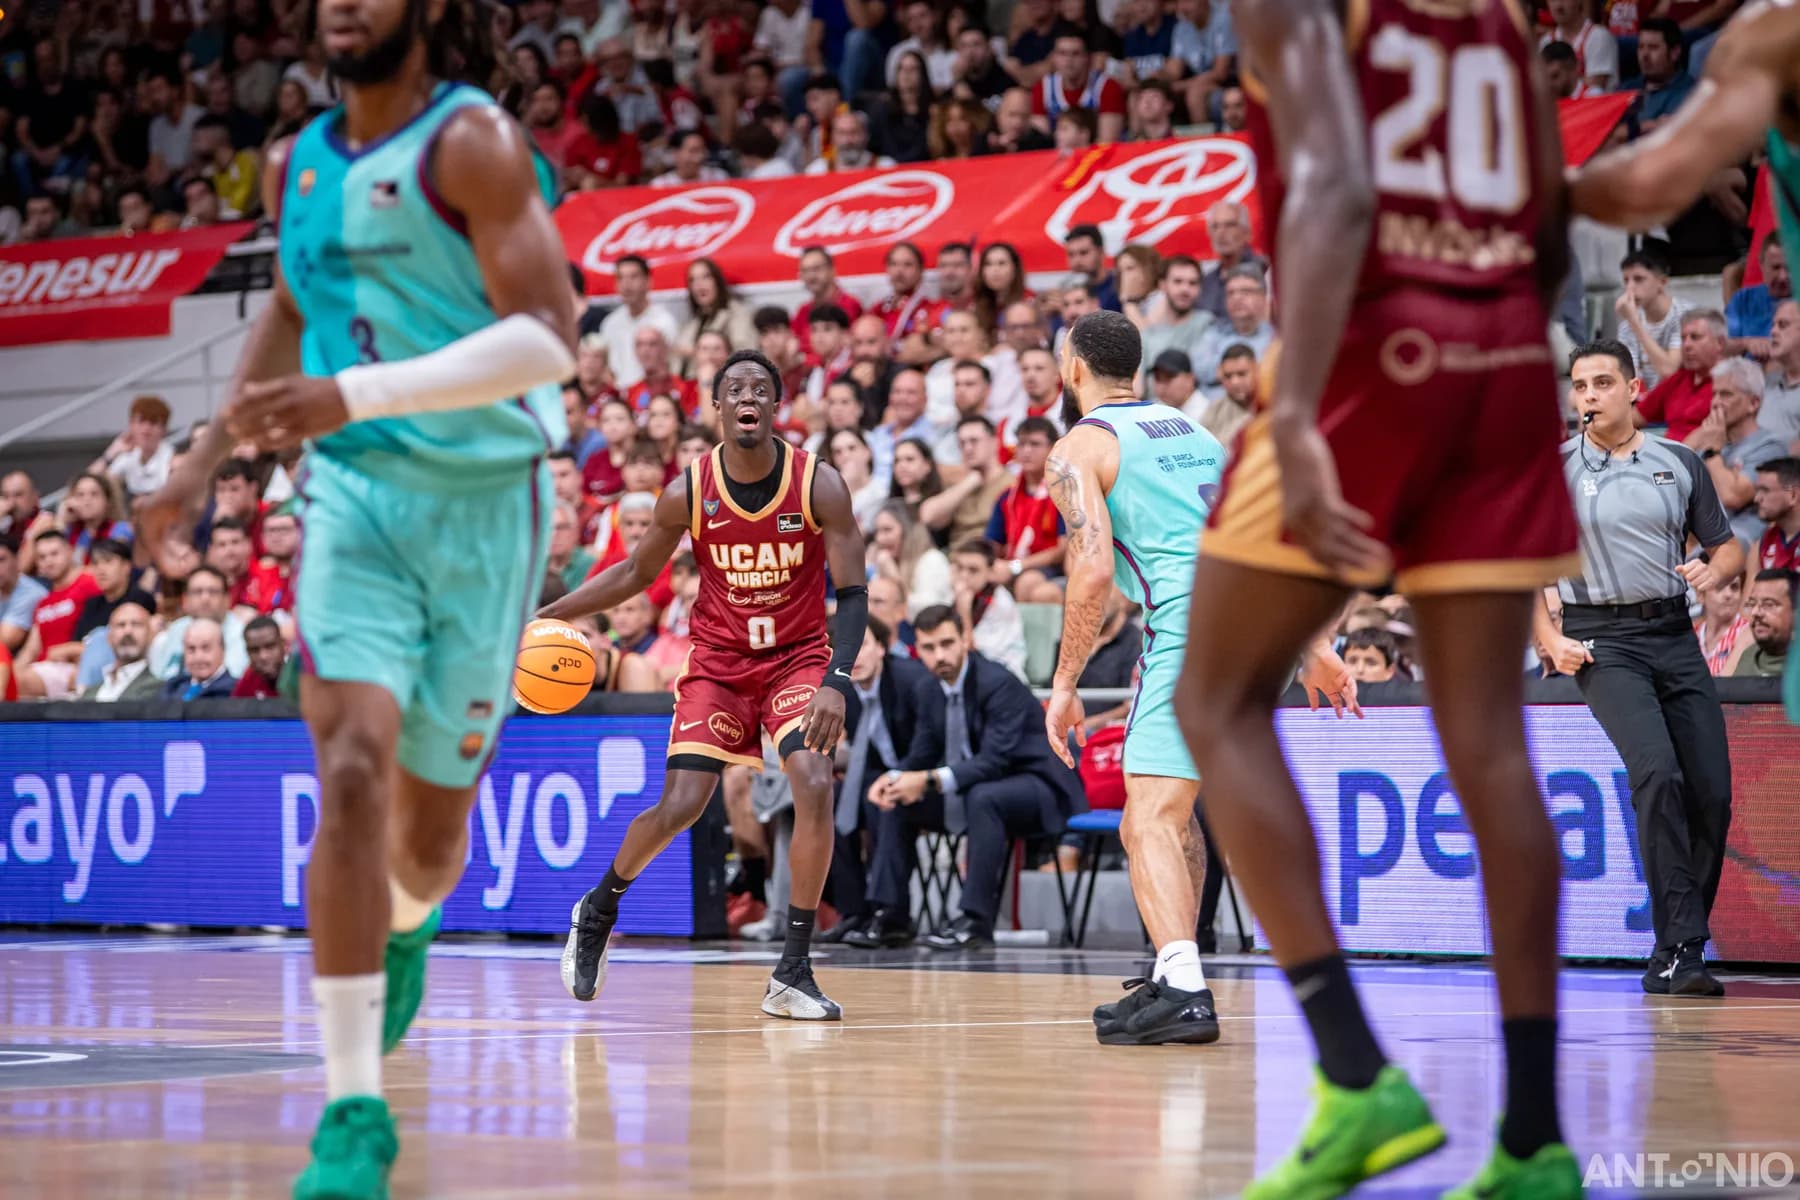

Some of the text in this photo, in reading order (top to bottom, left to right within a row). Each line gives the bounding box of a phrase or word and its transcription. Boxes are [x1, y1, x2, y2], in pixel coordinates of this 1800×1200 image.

[1369, 23, 1530, 215] 20
[604, 220, 731, 254] Juver
[794, 204, 929, 240] Juver
[0, 248, 181, 303] enesur
[1135, 417, 1195, 439] MARTIN
[708, 542, 805, 571] UCAM
[725, 569, 791, 589] MURCIA
[747, 616, 776, 650] 0
[558, 656, 582, 669] acb
[775, 691, 813, 711] Juver
[713, 719, 742, 740] Juver
[0, 773, 156, 903] ayo
